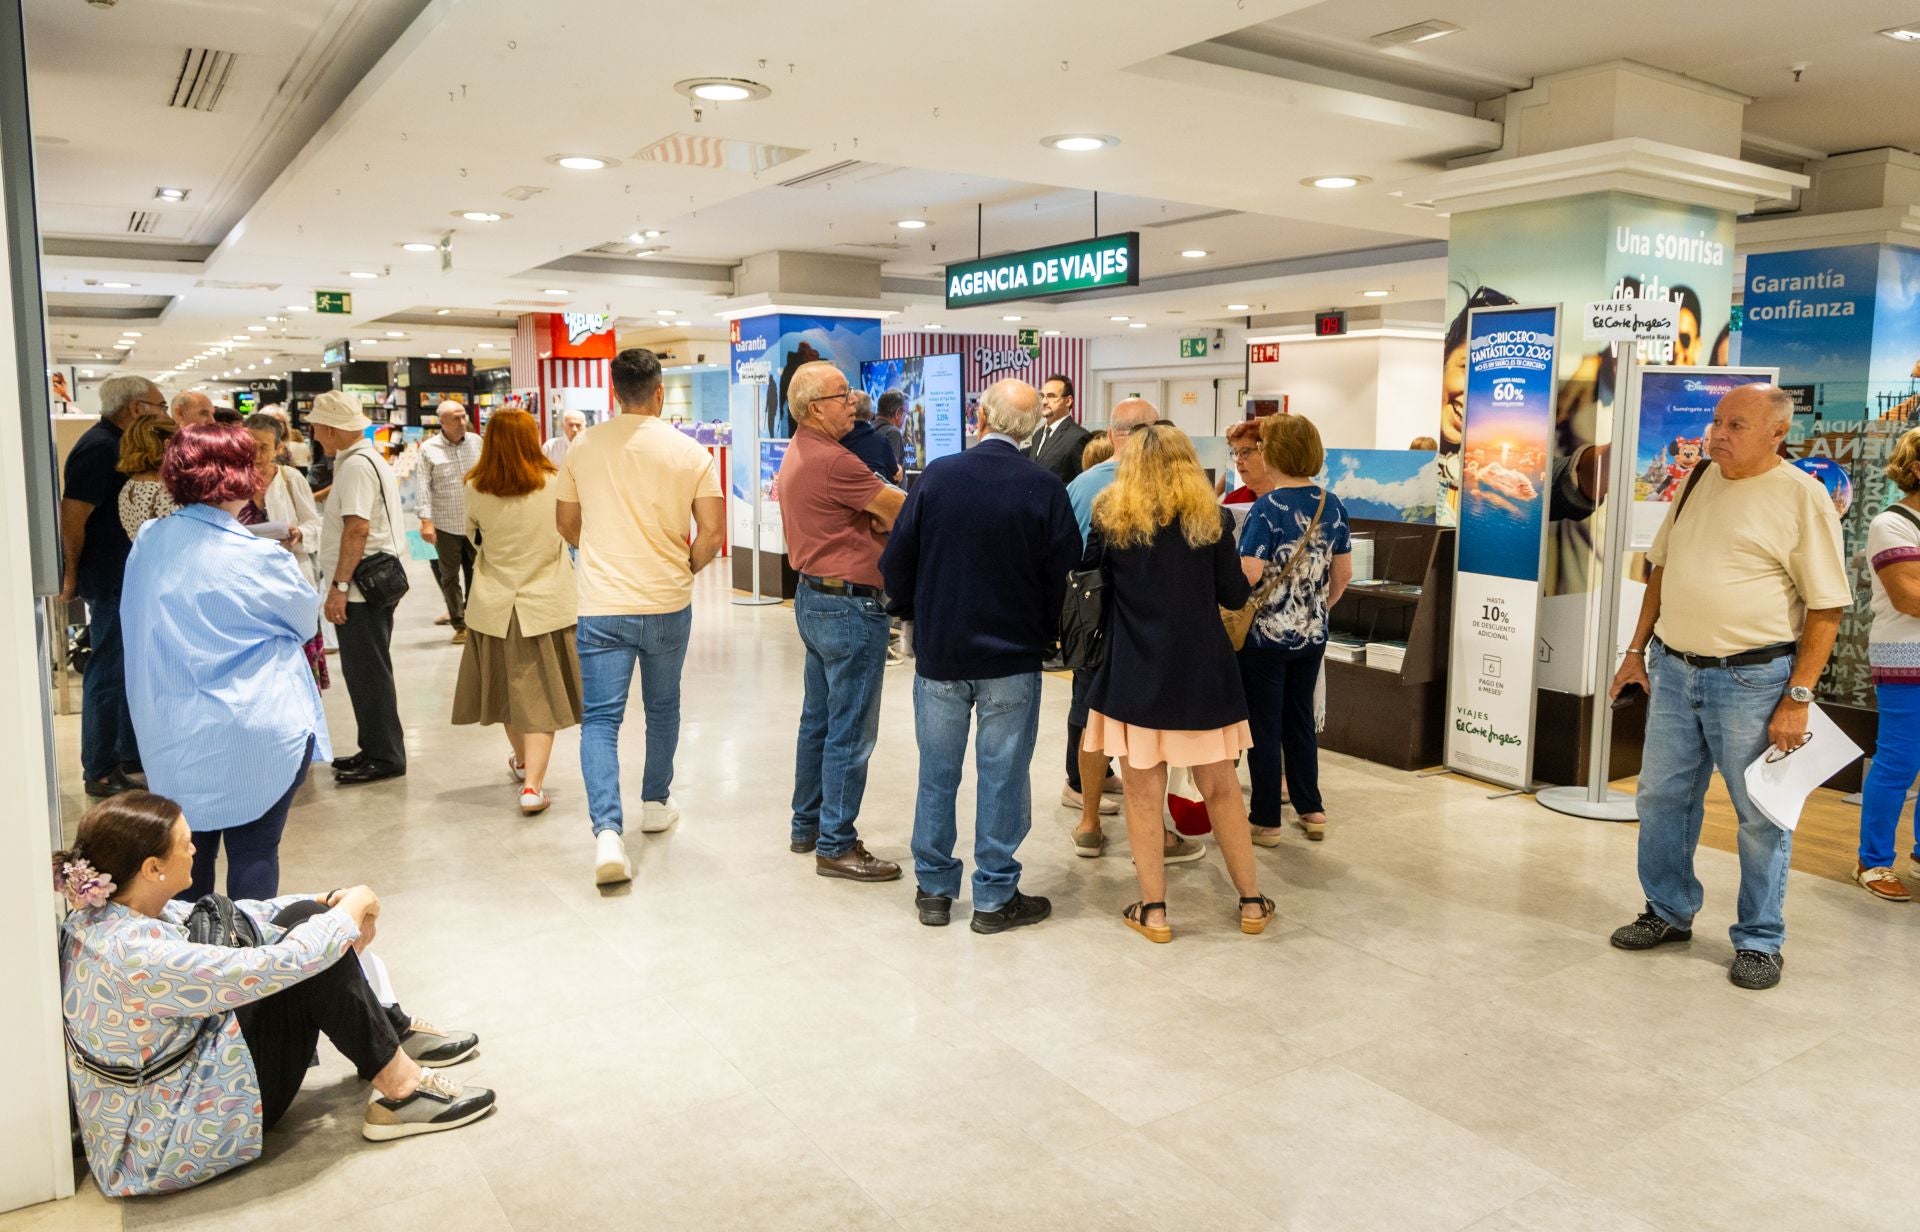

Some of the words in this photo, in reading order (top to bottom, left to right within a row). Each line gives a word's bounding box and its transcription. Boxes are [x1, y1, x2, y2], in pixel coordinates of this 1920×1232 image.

[1615, 225, 1650, 256] Una
[1655, 230, 1724, 266] sonrisa
[949, 264, 1028, 298] AGENCIA
[1032, 259, 1059, 286] DE
[1060, 247, 1128, 283] VIAJES
[1751, 268, 1845, 294] Garantía
[1613, 277, 1634, 300] de
[1639, 273, 1670, 302] ida
[1674, 291, 1685, 311] y
[1593, 303, 1632, 313] VIAJES
[1749, 299, 1855, 321] confianza
[1321, 317, 1338, 334] 09
[1592, 316, 1604, 328] El
[1604, 316, 1631, 328] Corte
[1632, 313, 1671, 332] Inglés
[1488, 331, 1537, 345] CRUCERO
[1471, 343, 1525, 364] FANTÁSTICO
[1525, 345, 1552, 361] 2026
[1610, 340, 1673, 362] velta
[974, 347, 1032, 376] BELROS
[250, 382, 278, 391] CAJA
[1494, 383, 1525, 401] 60%
[1486, 597, 1505, 605] HASTA
[1481, 605, 1510, 624] 10%
[1477, 630, 1508, 641] ADICIONAL
[1481, 622, 1516, 634] DESCUENTO
[1488, 663, 1495, 673] 6
[1478, 678, 1494, 687] PAGO
[1457, 706, 1489, 720] VIAJES
[1455, 718, 1465, 731] El
[1465, 722, 1487, 737] Corte
[1487, 723, 1522, 746] Inglés
